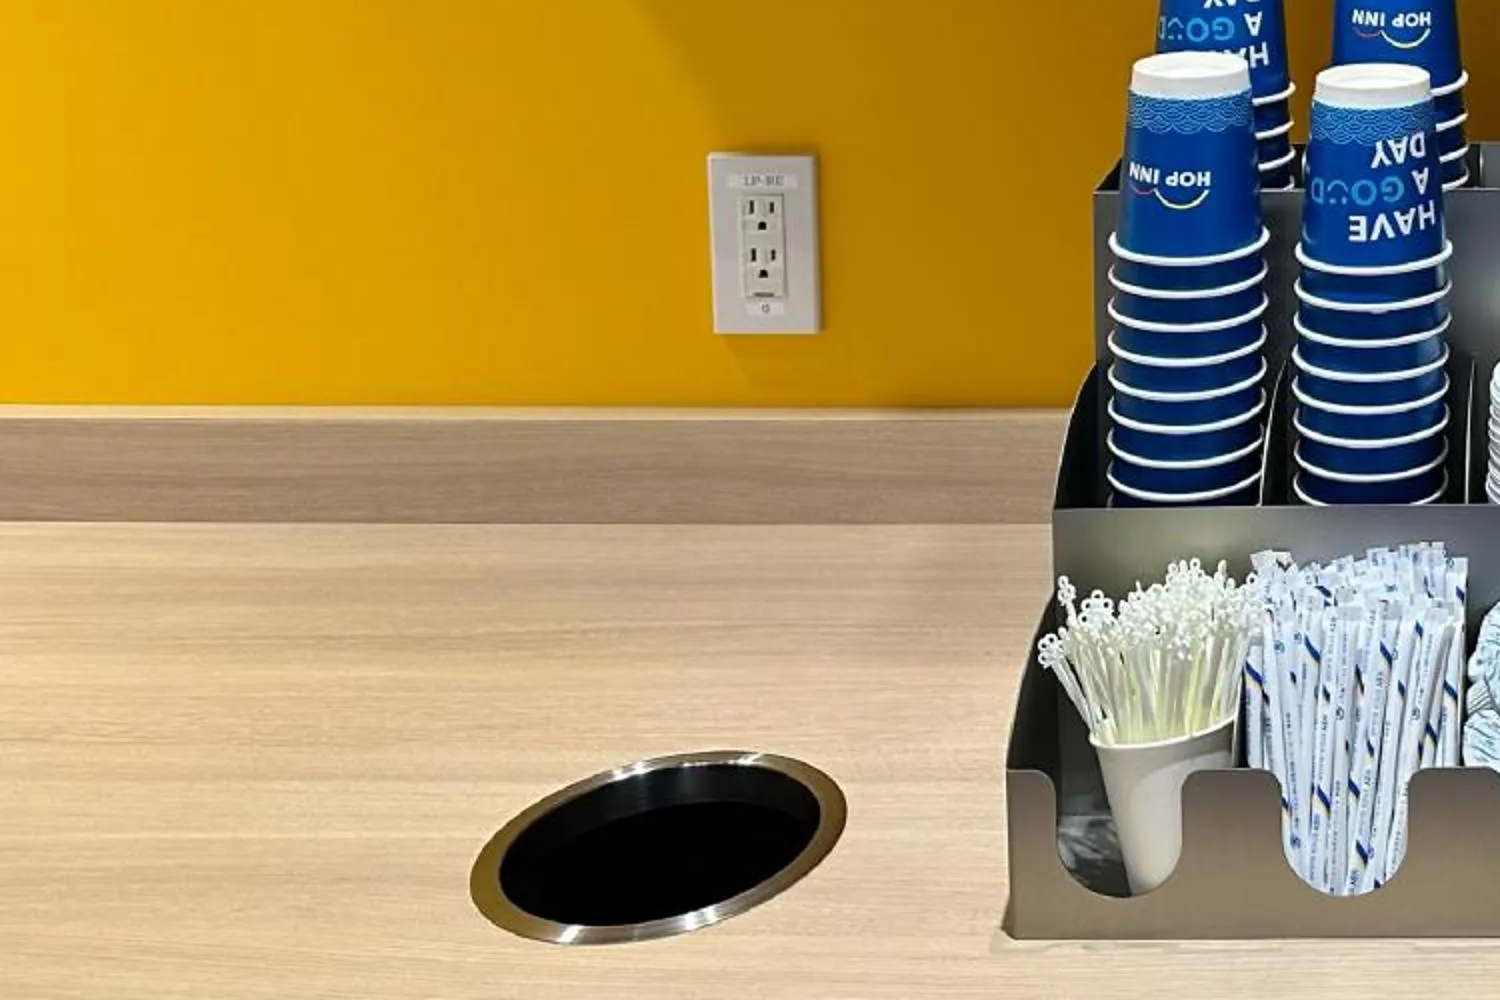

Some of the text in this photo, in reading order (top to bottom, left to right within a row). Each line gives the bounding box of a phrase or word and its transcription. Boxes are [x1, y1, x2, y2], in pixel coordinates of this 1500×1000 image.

[1243, 10, 1263, 37] A
[1351, 8, 1432, 28] HOP INN
[1370, 131, 1427, 169] DAY
[1129, 160, 1212, 188] HOP INN
[1411, 166, 1430, 195] A
[1348, 199, 1436, 242] HAVE
